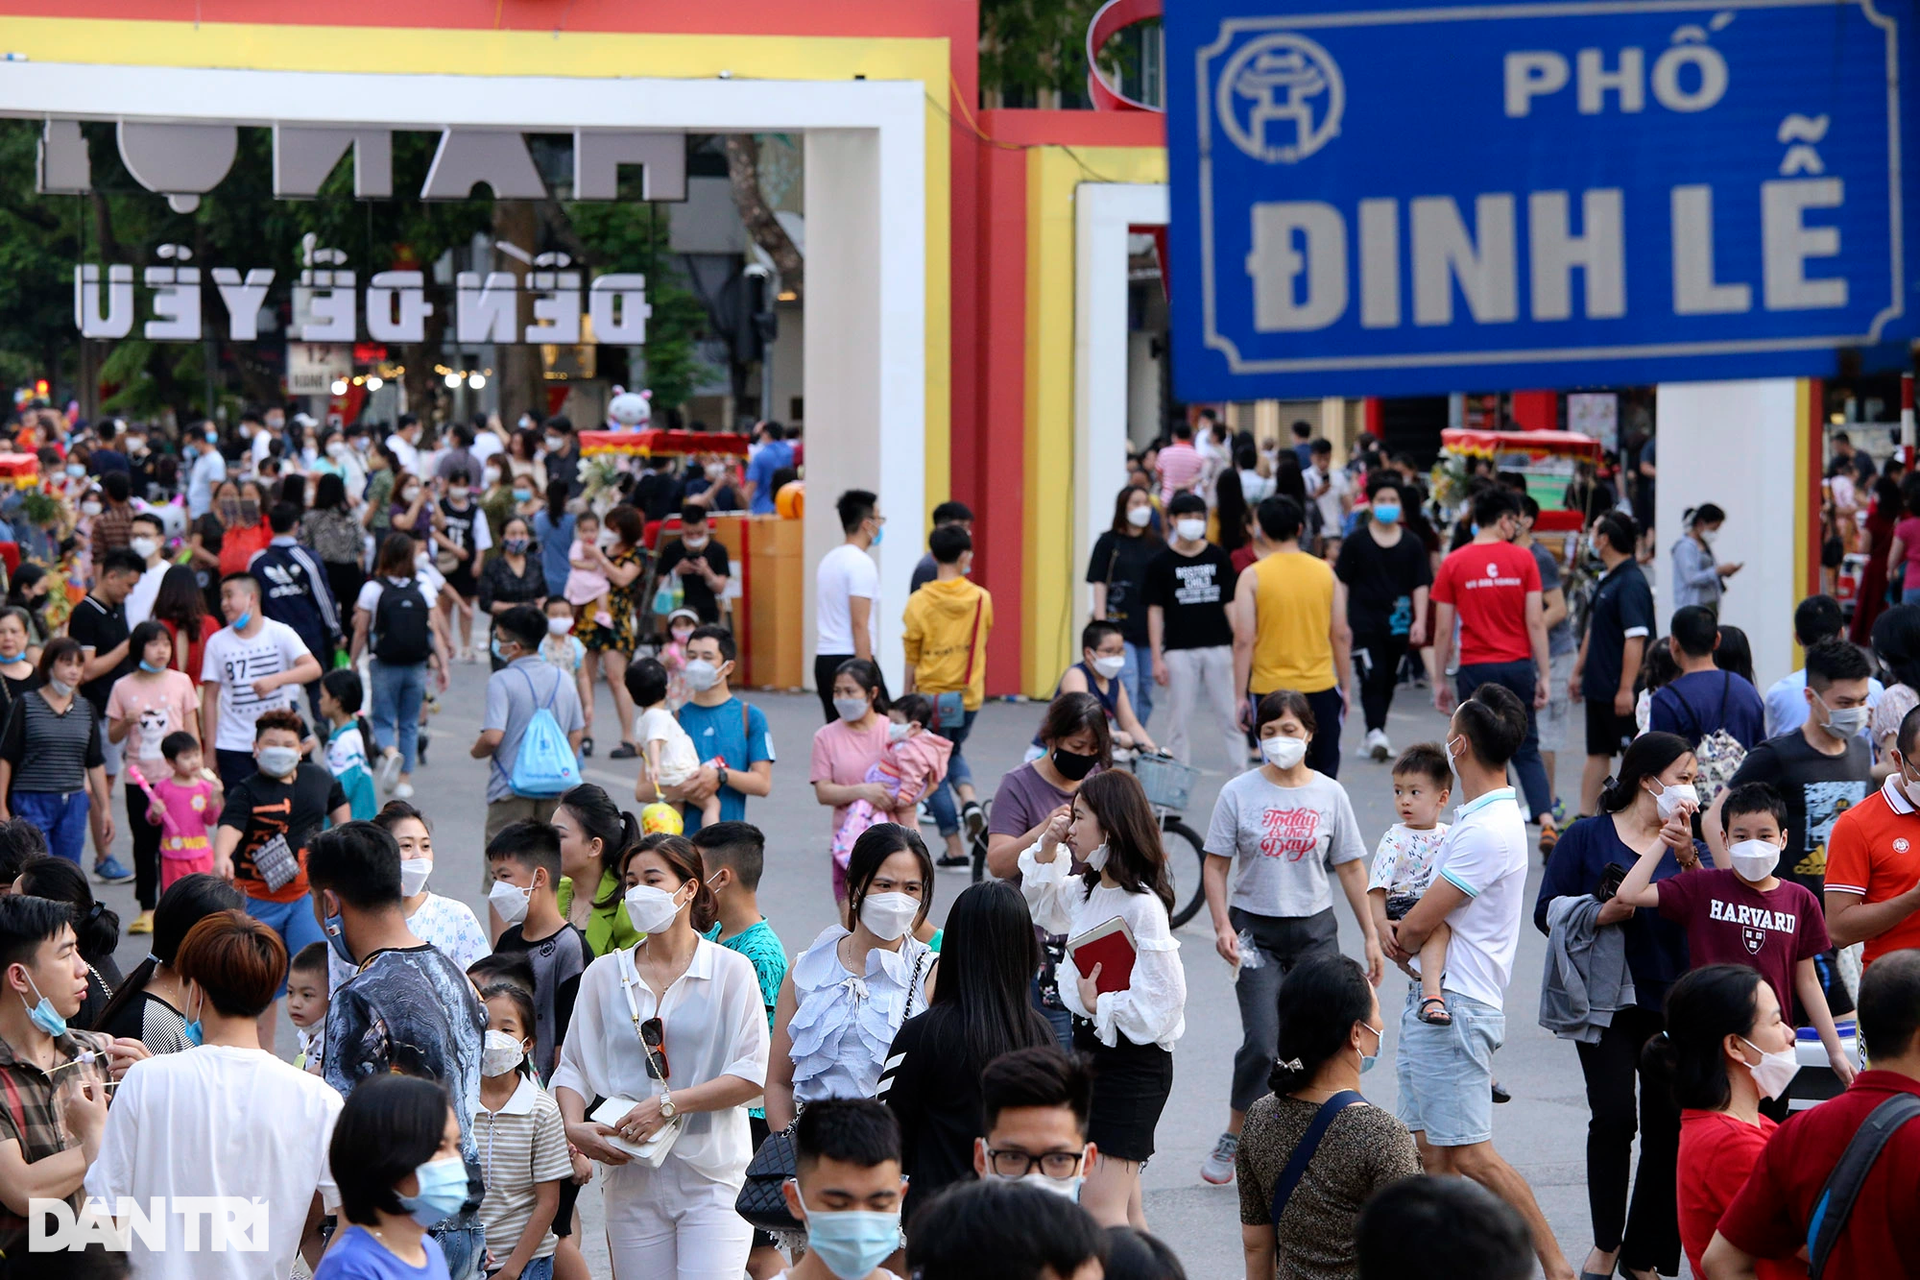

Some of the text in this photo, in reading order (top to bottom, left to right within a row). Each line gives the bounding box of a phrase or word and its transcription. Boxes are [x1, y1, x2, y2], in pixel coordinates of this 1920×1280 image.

[1503, 11, 1733, 118] PHỐ
[1245, 113, 1849, 333] ĐINH LỄ
[225, 659, 247, 681] 87
[1262, 807, 1320, 838] Today
[1284, 826, 1308, 838] the
[1261, 838, 1317, 862] Day
[1709, 899, 1796, 934] HARVARD
